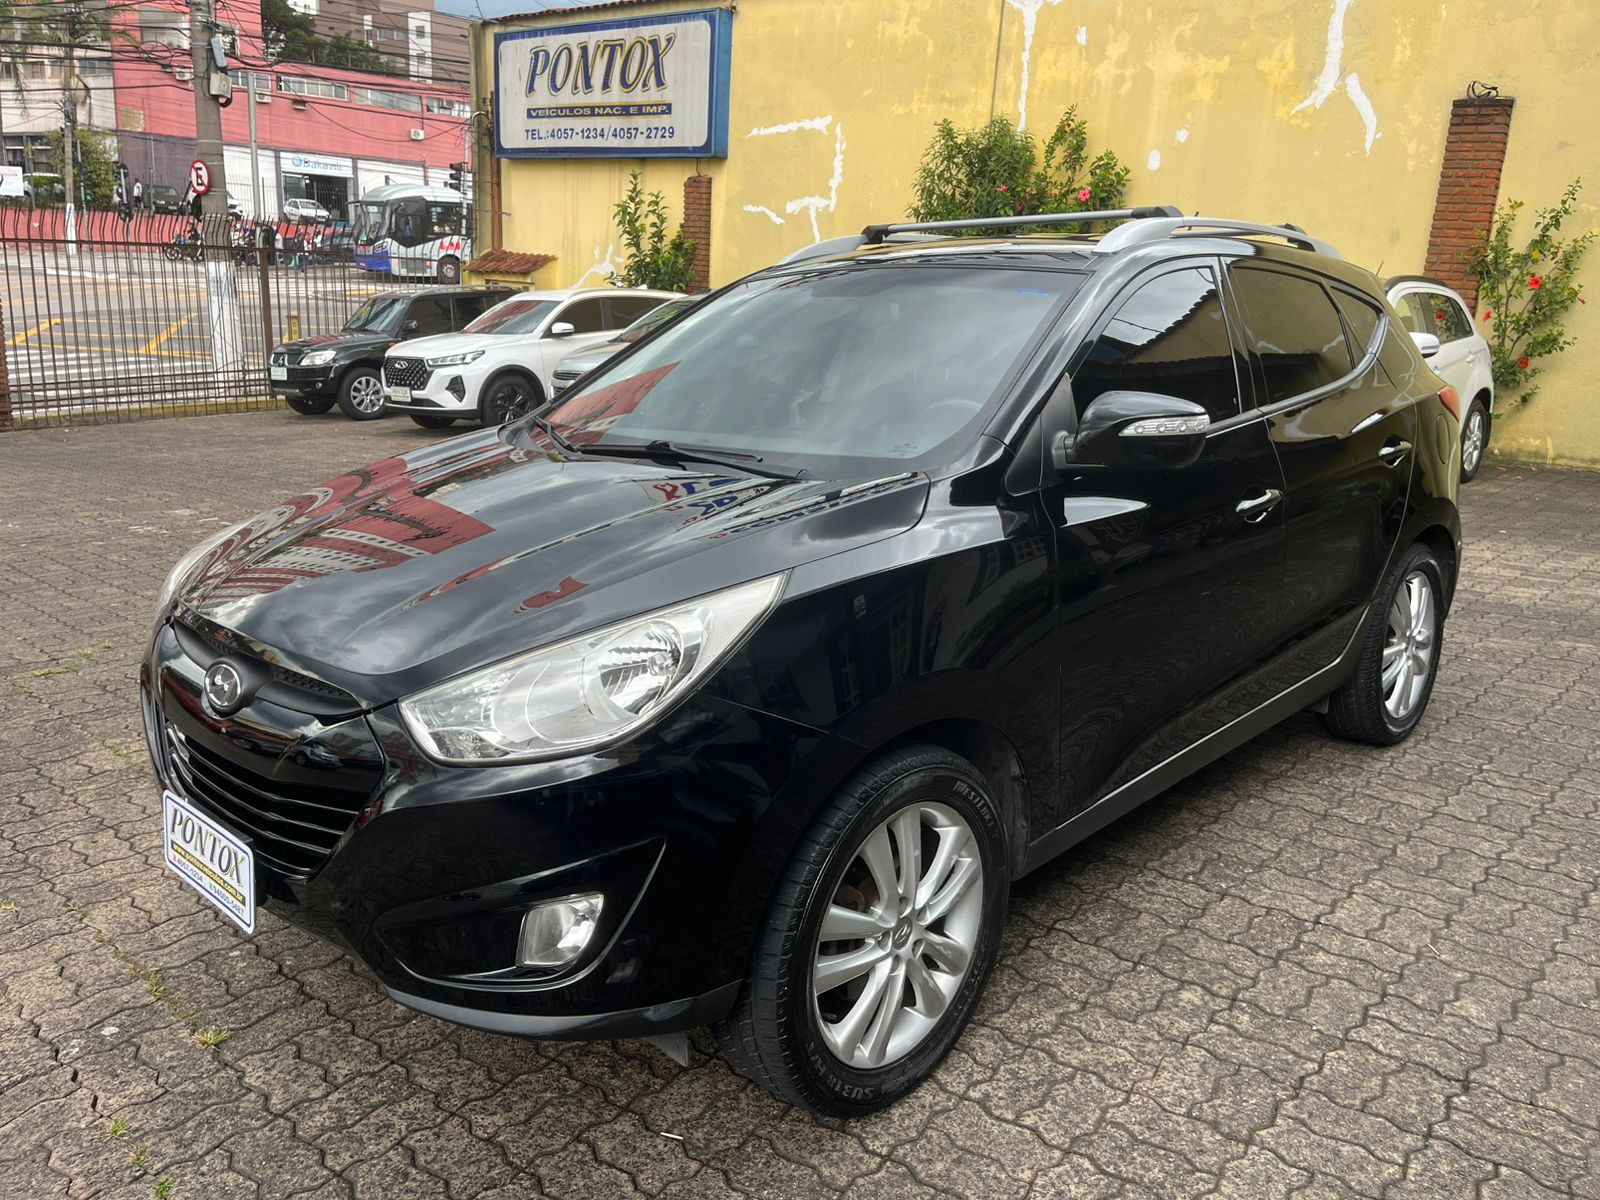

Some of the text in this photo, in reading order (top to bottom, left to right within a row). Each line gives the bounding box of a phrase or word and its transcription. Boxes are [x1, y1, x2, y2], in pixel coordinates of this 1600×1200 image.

[525, 32, 676, 98] PONTOX
[595, 107, 625, 115] NAC.
[630, 106, 638, 114] E
[642, 105, 668, 114] IMP.
[171, 805, 245, 888] PONTOX
